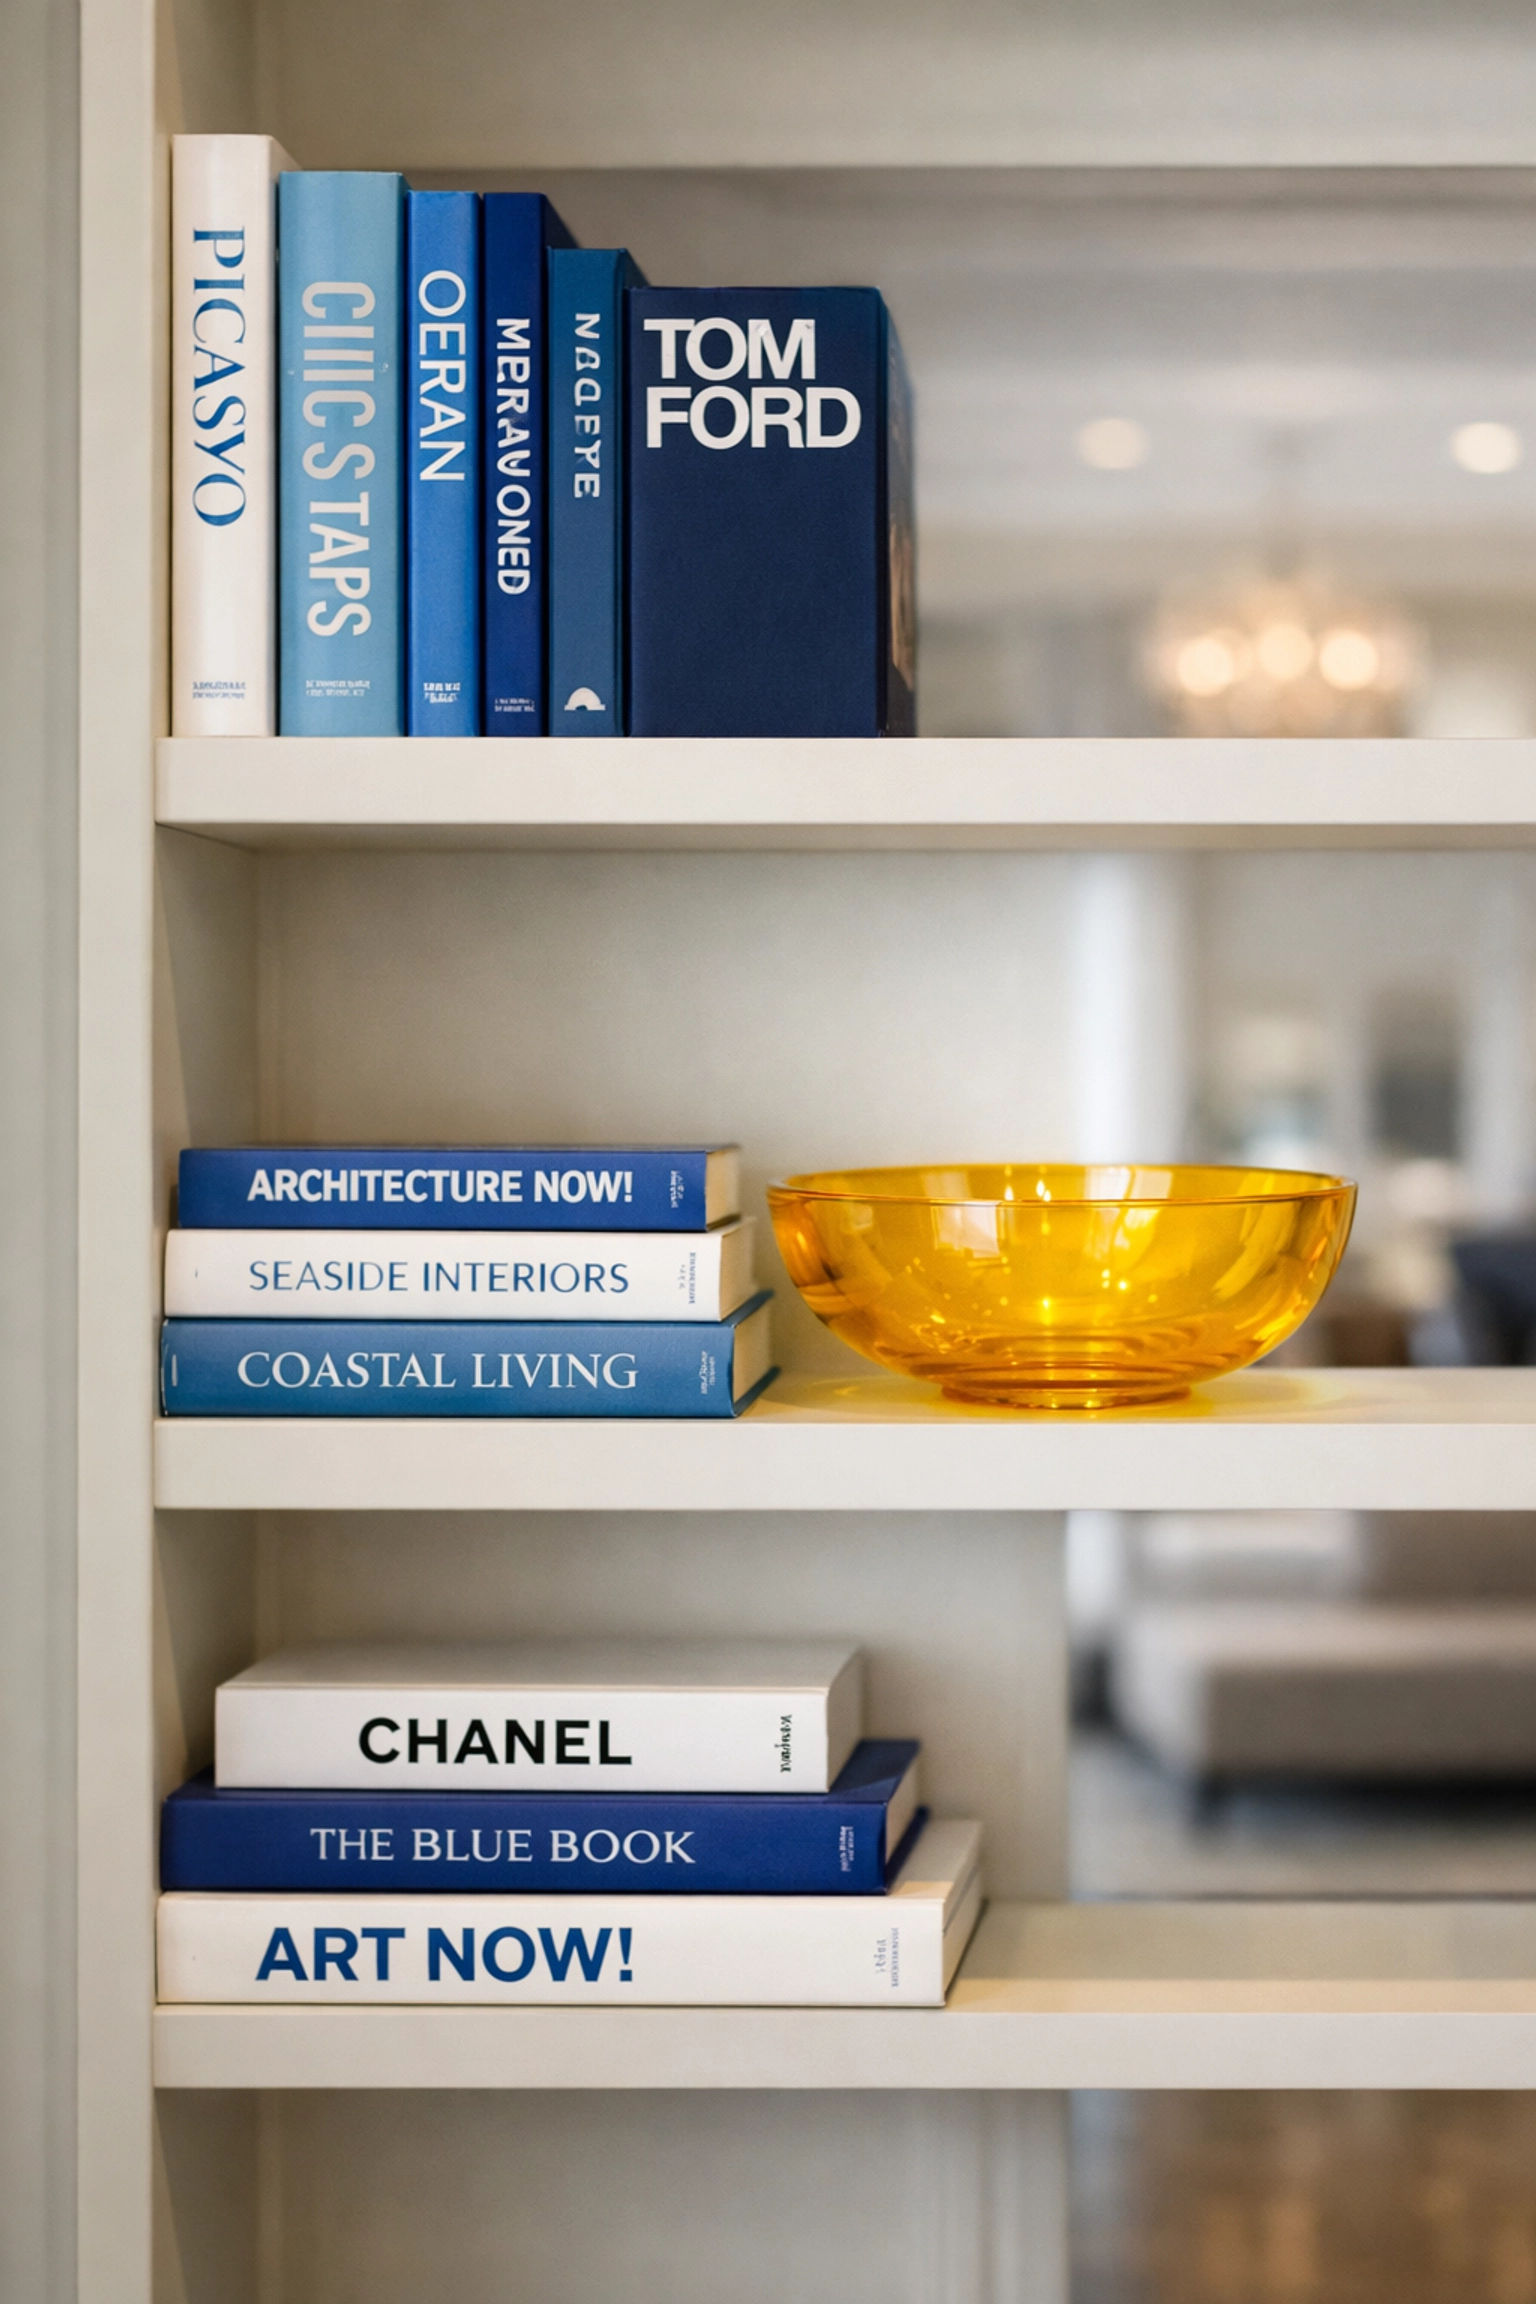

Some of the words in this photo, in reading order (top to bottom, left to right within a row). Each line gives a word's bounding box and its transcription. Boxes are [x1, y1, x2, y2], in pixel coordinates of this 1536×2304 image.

[643, 317, 816, 381] TOM
[193, 229, 246, 527] PICASYO
[418, 270, 466, 481] OERAN
[647, 385, 861, 450] FORD
[247, 1168, 523, 1203] ARCHITECTURE
[534, 1168, 633, 1203] NOW!
[250, 1261, 408, 1292] SEASIDE
[423, 1261, 629, 1293] INTERIORS
[238, 1351, 456, 1388] COASTAL
[472, 1351, 637, 1389] LIVING
[358, 1717, 632, 1765] CHANEL
[310, 1828, 394, 1862] THE
[413, 1828, 533, 1863] BLUE
[550, 1828, 696, 1864] BOOK
[255, 1926, 406, 1982] ART
[428, 1926, 633, 1983] NOW!
